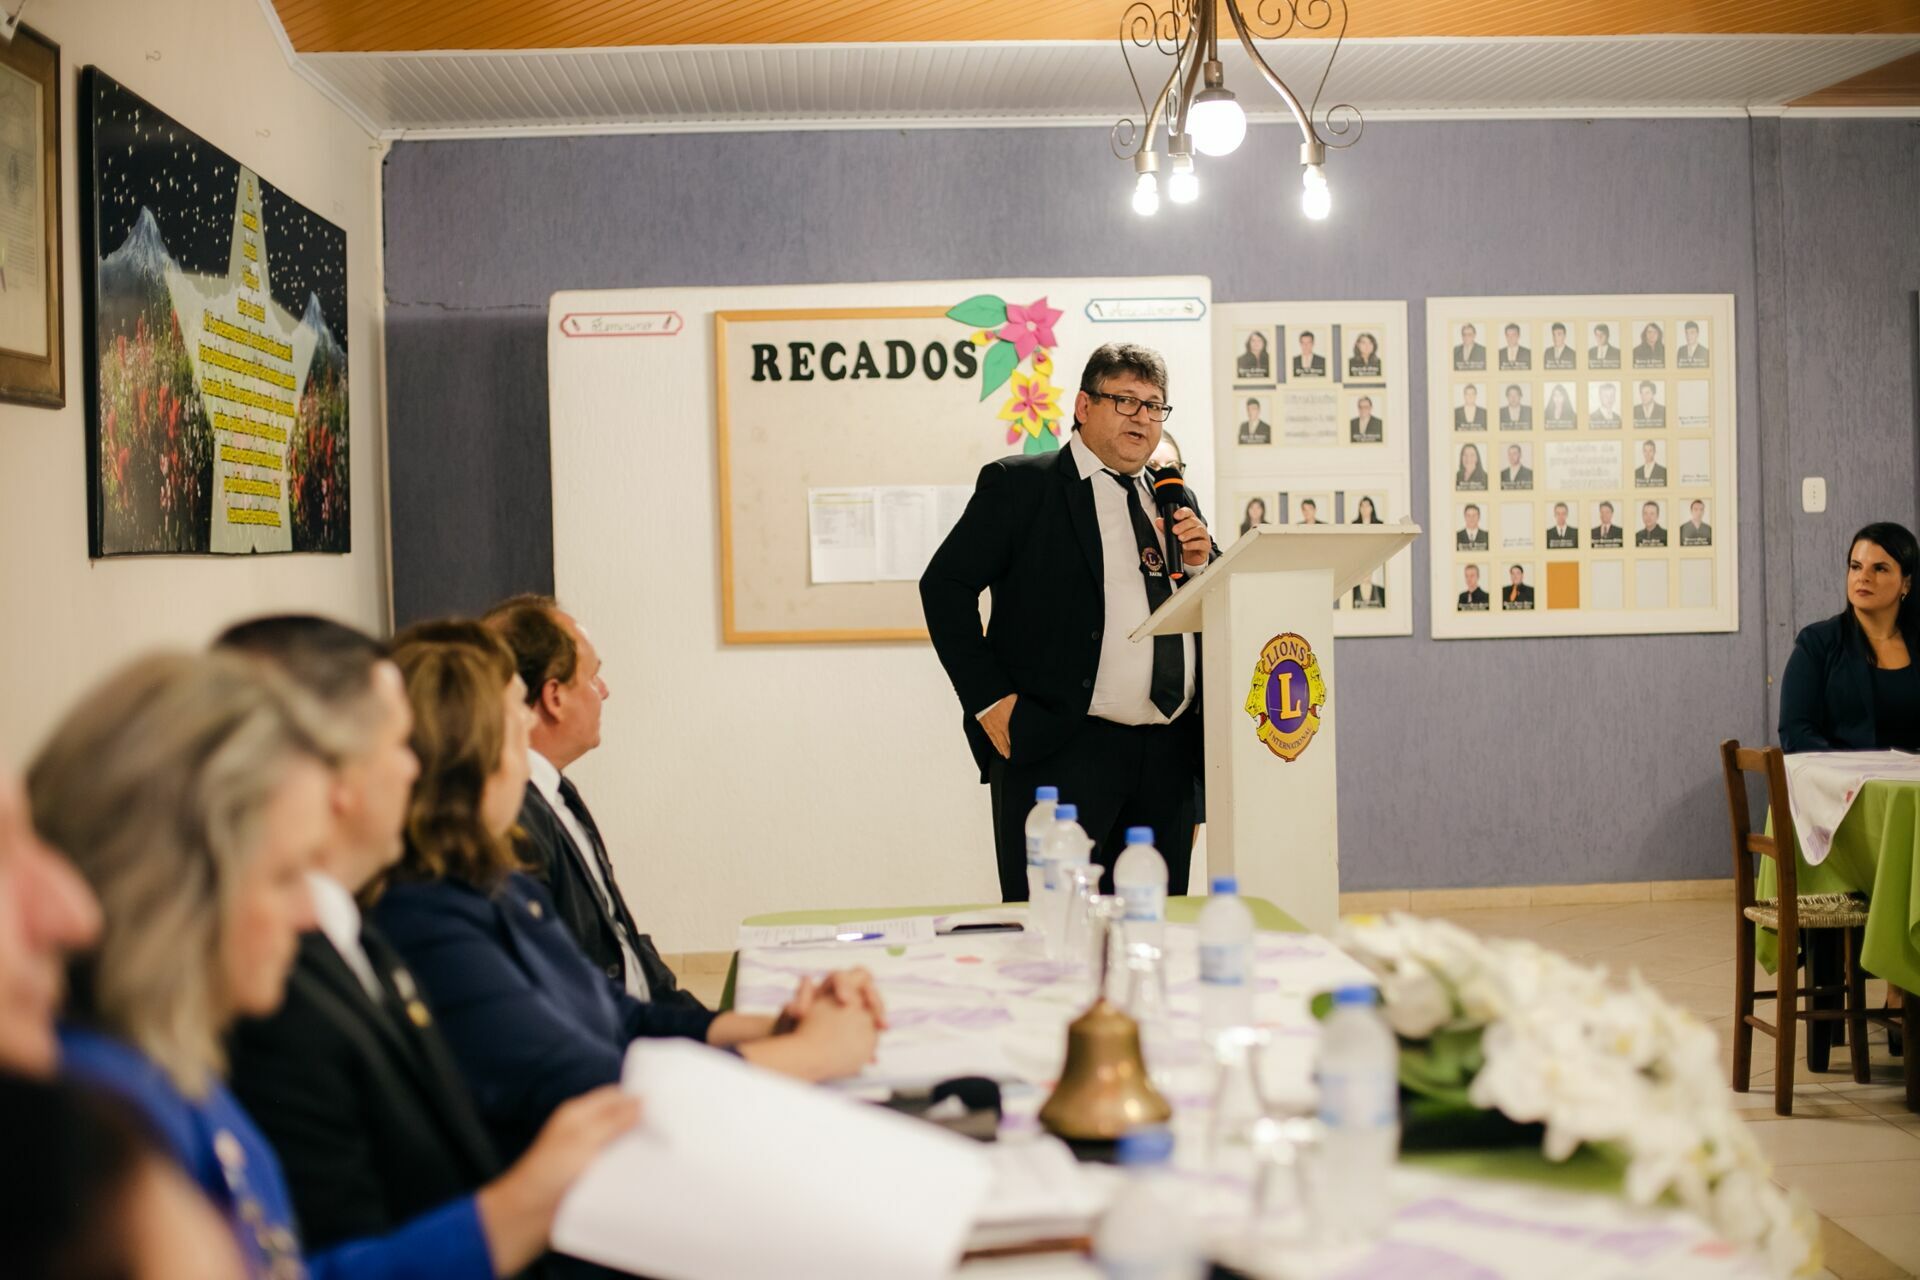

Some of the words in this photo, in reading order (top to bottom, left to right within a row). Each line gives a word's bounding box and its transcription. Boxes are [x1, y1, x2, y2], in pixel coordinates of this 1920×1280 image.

[751, 340, 978, 381] RECADOS
[1266, 641, 1307, 667] LIONS
[1278, 672, 1302, 720] L
[1268, 728, 1311, 751] INTERNATIONAL
